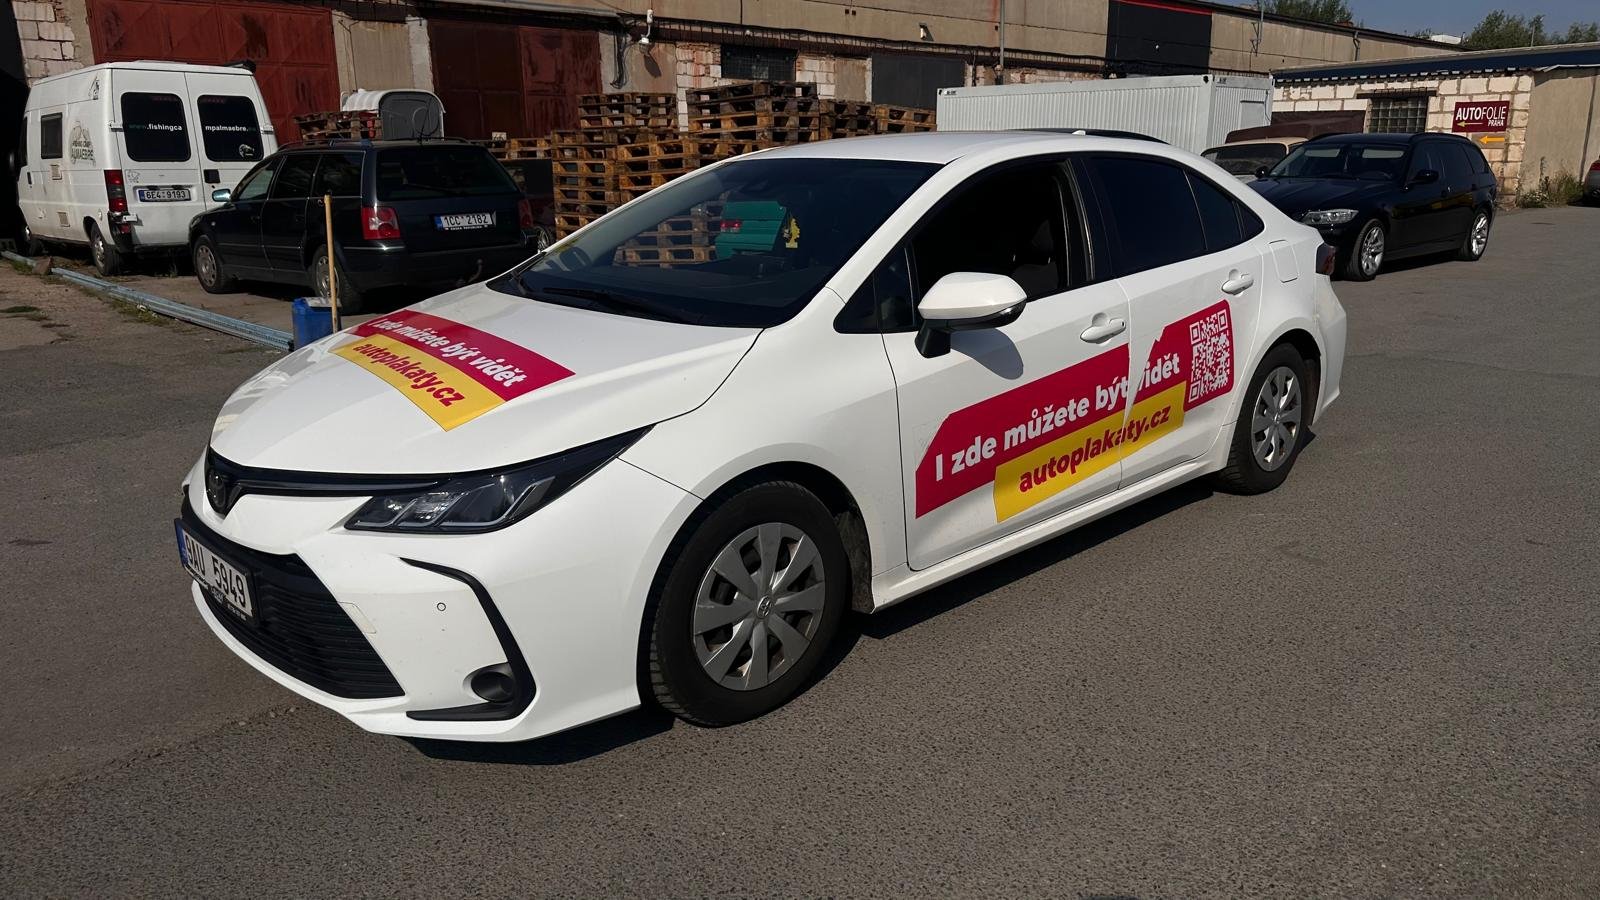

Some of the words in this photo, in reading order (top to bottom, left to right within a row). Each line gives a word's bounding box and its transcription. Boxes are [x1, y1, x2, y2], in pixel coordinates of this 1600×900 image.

[1455, 106, 1507, 120] AUTOFOLIE
[466, 214, 488, 225] 2182
[352, 343, 465, 407] autoplakaty.cz
[440, 342, 481, 361] být
[469, 356, 528, 387] vidět
[935, 453, 944, 482] I
[951, 435, 997, 475] zde
[1003, 397, 1091, 451] můžete
[1095, 376, 1129, 411] být
[1018, 404, 1172, 493] autoplakaty.cz
[211, 554, 246, 608] 5949
